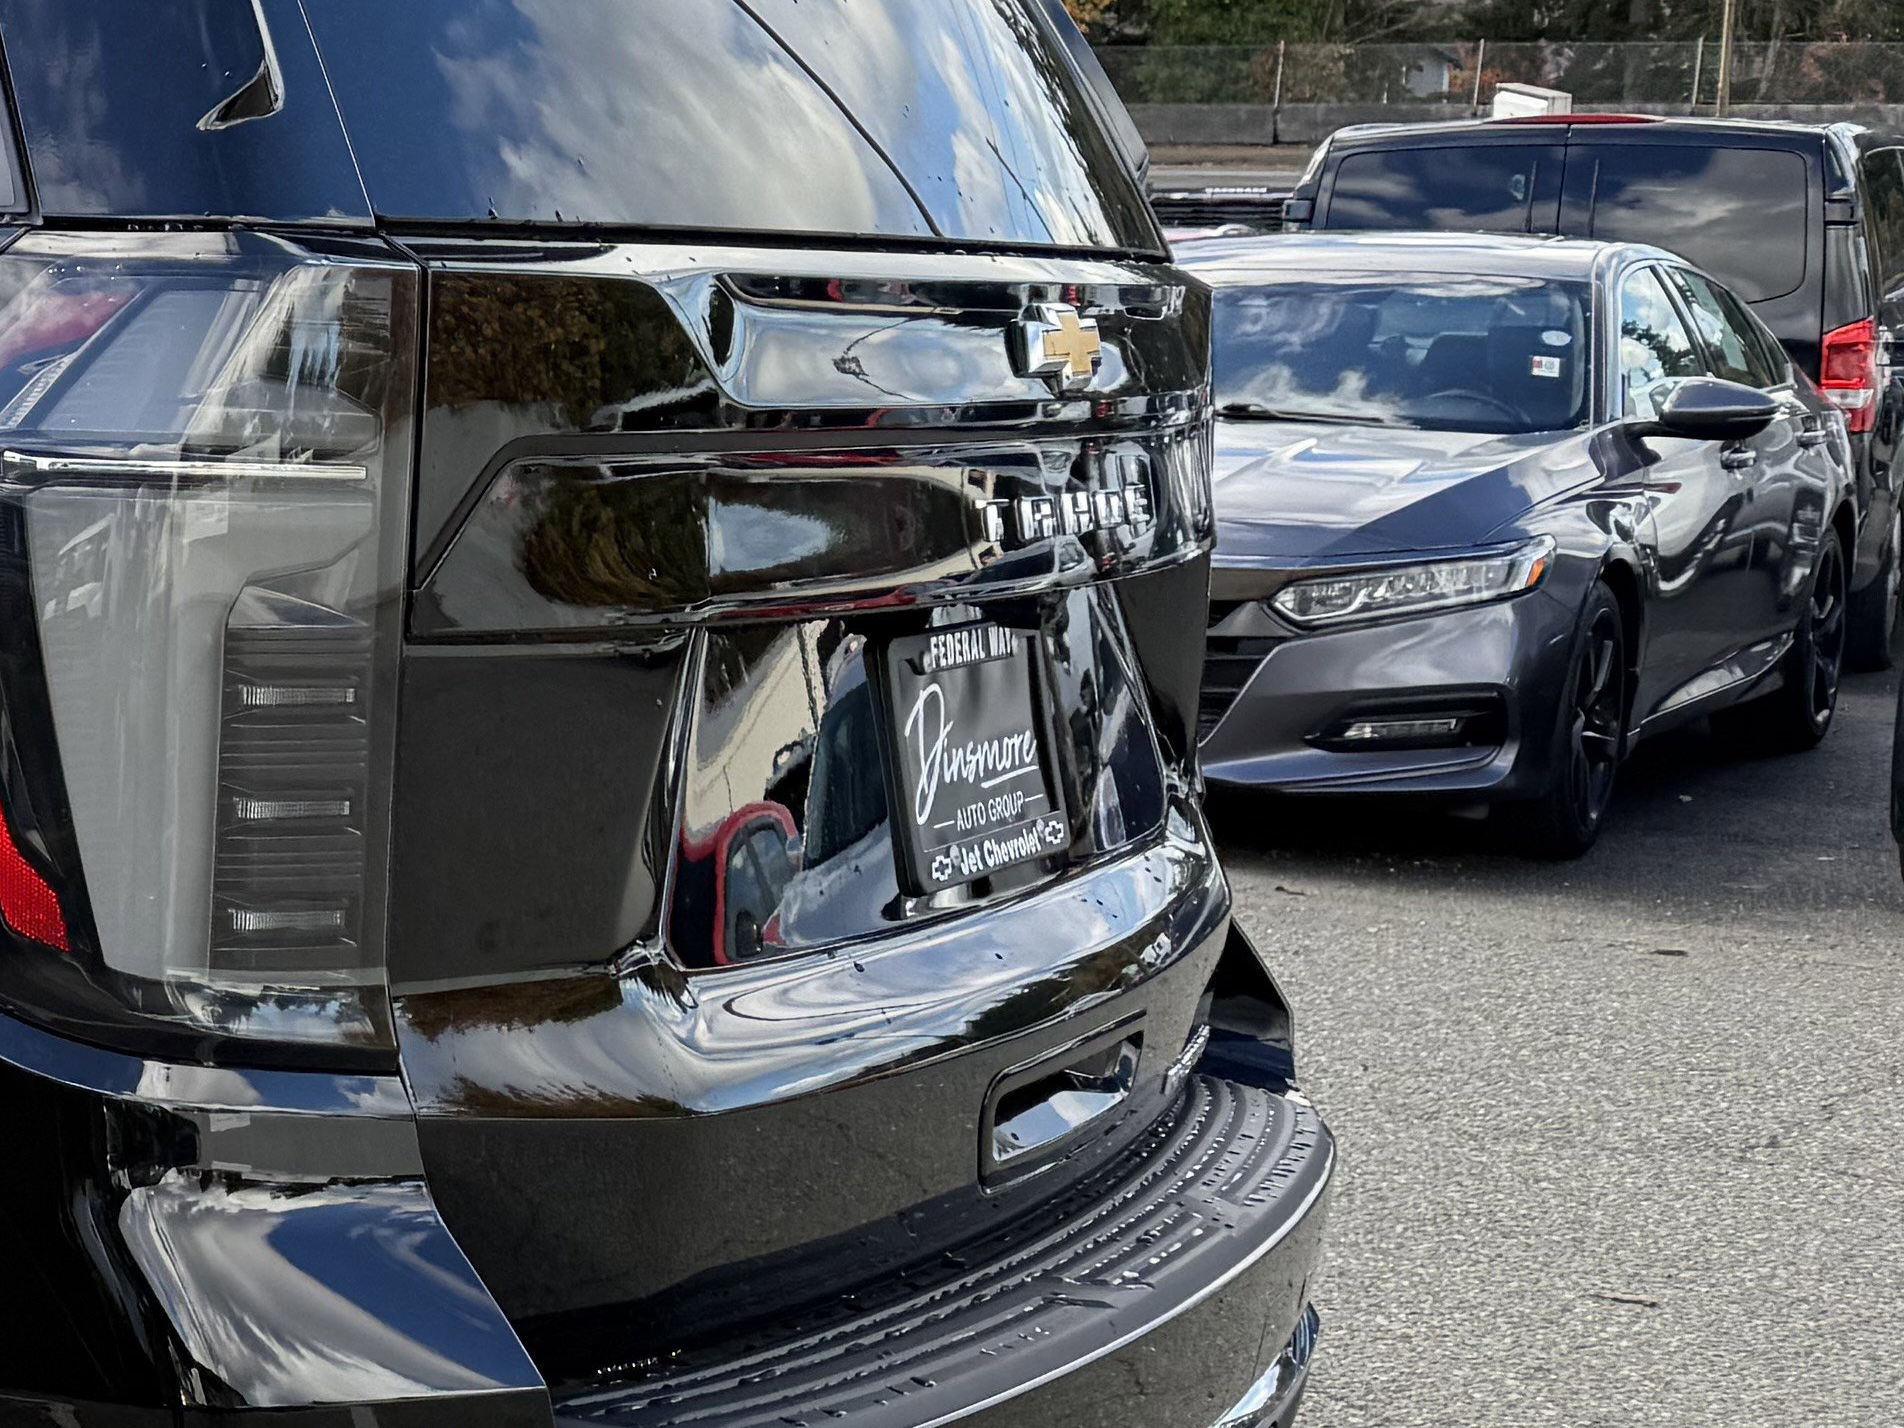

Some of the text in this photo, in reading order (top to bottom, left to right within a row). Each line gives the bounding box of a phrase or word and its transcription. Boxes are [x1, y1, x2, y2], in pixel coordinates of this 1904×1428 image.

[929, 626, 1014, 669] FEDERAL WAY
[904, 683, 1037, 825] Dinsmore
[957, 790, 1025, 831] AUTO GROUP
[960, 827, 1041, 876] Jet Chevrolet
